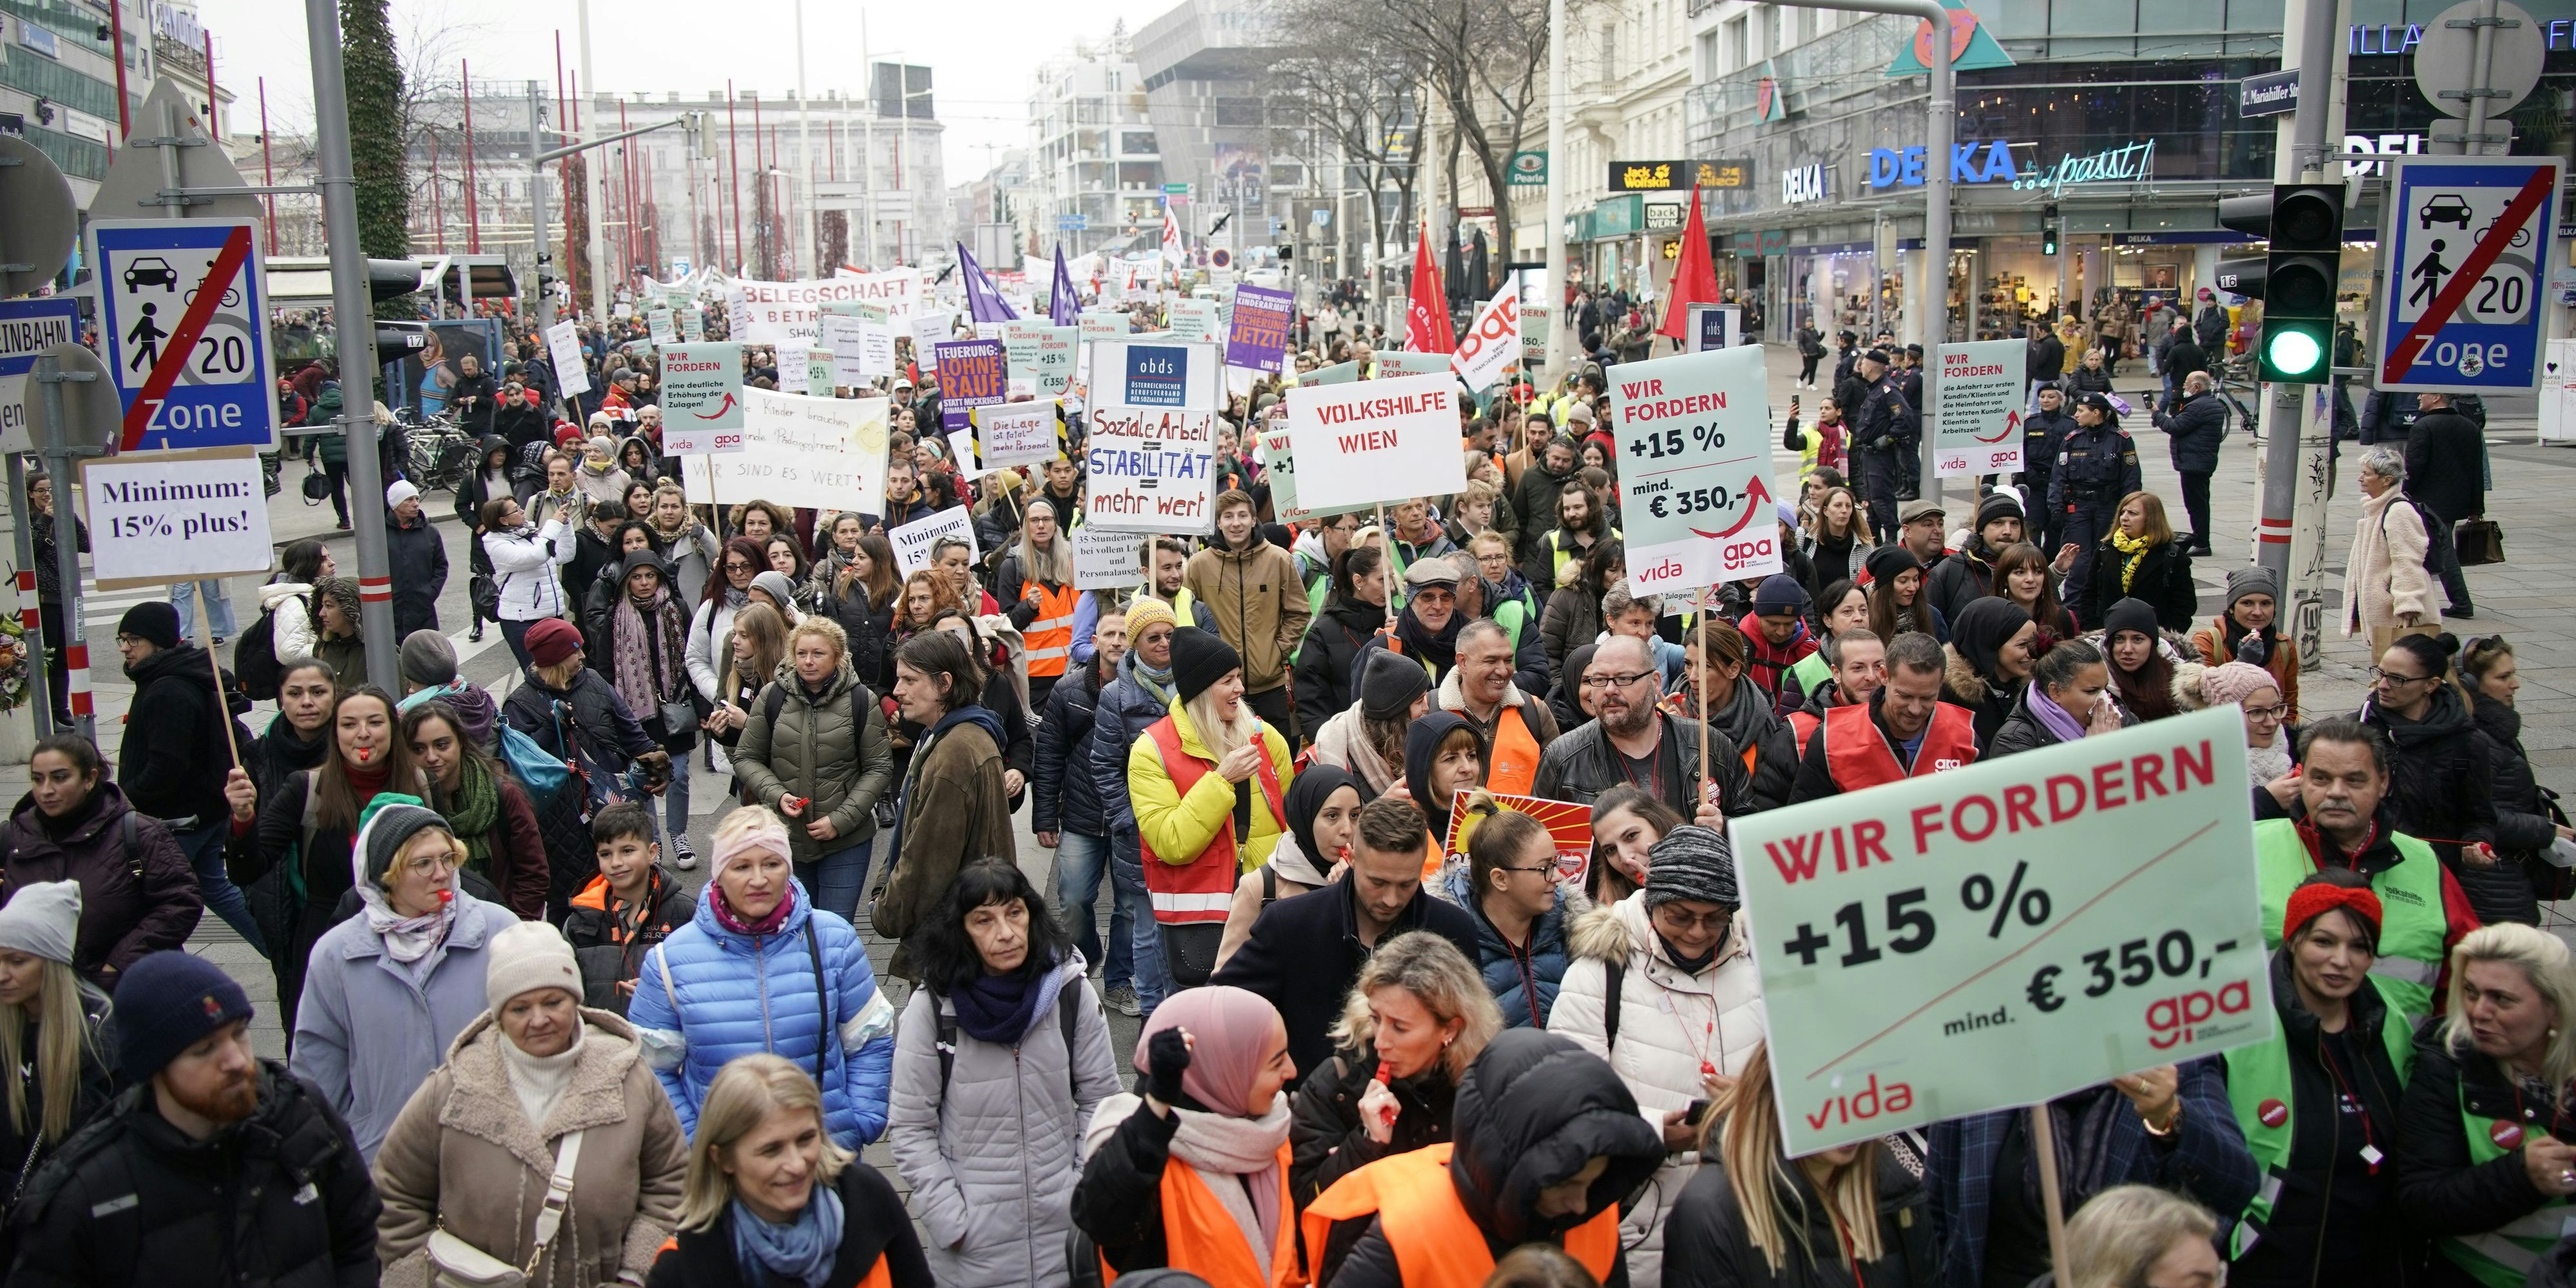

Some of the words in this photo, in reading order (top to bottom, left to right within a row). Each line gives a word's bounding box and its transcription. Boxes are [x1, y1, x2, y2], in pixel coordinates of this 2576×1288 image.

[2349, 23, 2420, 55] ILLA
[2251, 85, 2288, 104] Mariahilfer
[2289, 82, 2299, 97] Str
[1871, 140, 2016, 187] DEKA
[1515, 173, 1545, 183] Pearle
[1624, 166, 1651, 178] Jack
[1624, 176, 1670, 189] Wolfskin
[1783, 164, 1823, 204] DELKA
[1650, 207, 1675, 217] back
[1648, 218, 1678, 228] WERK
[2222, 276, 2236, 287] 16
[742, 278, 909, 303] BELEGSCHAFT
[2477, 276, 2523, 314] 20
[1236, 297, 1291, 312] KINDERARMUT.
[747, 313, 755, 323] &
[1234, 313, 1288, 331] SICHERUNG
[0, 319, 66, 353] INBAHN
[1707, 321, 1720, 336] obds
[408, 335, 422, 347] 17
[1231, 325, 1285, 350] JETZT!
[202, 336, 244, 375] 20
[667, 352, 688, 361] WIR
[936, 345, 998, 359] TEUERUNG:
[1041, 355, 1056, 364] +15
[1059, 354, 1066, 363] %
[1528, 348, 1544, 356] gpa
[2411, 334, 2508, 368] Zone
[667, 362, 721, 373] FORDERN
[939, 356, 1000, 377] LÖHNE
[1140, 358, 1173, 374] obds
[1382, 359, 1401, 368] WIR
[1945, 354, 1969, 365] WIR
[809, 366, 820, 379] +15
[1944, 365, 2003, 378] FORDERN
[687, 381, 724, 389] deutliche
[942, 374, 1001, 399] RAUF
[1050, 377, 1068, 386] 350,-
[1131, 381, 1180, 390] ÖSTERREICHISCHER
[1303, 379, 1320, 388] WIR
[1620, 379, 1663, 400] WIR
[668, 392, 706, 400] Erhöhung
[943, 398, 963, 407] STATT
[964, 396, 1003, 406] MICKRIGER
[1944, 391, 1996, 400] Kundin/Klientin
[668, 401, 704, 409] Zulagen!
[764, 398, 795, 417] Kinder
[808, 406, 850, 428] brauchen
[1317, 391, 1447, 426] VOLKSHILFE
[1624, 392, 1727, 424] FORDERN
[144, 398, 243, 431] Zone
[994, 421, 1009, 430] Die
[1012, 419, 1040, 433] Lage
[1092, 409, 1154, 437] Soziale
[1156, 412, 1210, 442] Arbeit
[715, 434, 740, 448] gpa
[993, 431, 1003, 439] ist
[1007, 431, 1027, 440] fatal
[1268, 435, 1291, 451] WI
[1338, 429, 1398, 454] WIEN
[1629, 429, 1685, 459] +15
[1693, 421, 1725, 452] %
[669, 439, 693, 450] vida
[993, 443, 1014, 451] mehr
[1016, 439, 1050, 451] Personal
[1090, 448, 1212, 478] STABILITÄT
[1940, 457, 1966, 469] vida
[1991, 451, 2017, 468] gpa
[693, 462, 723, 478] WR
[737, 462, 773, 477] SIND
[782, 467, 797, 480] ES
[102, 480, 250, 504] Minimum:
[1633, 478, 1674, 495] mind.
[1095, 488, 1149, 515] mehr
[1157, 491, 1205, 517] wert
[1649, 495, 1669, 518] €
[1676, 486, 1746, 515] 350,-
[109, 513, 173, 538] 15%
[182, 509, 249, 541] plus!
[898, 518, 964, 548] Minimum:
[1079, 535, 1088, 544] 35
[1081, 547, 1094, 555] bei
[1096, 545, 1124, 554] vollem
[1723, 538, 1772, 570] gpa
[1110, 556, 1125, 565] und
[1639, 558, 1683, 583] vida
[1665, 605, 1676, 614] vida
[1763, 819, 1894, 885] WIR
[1911, 739, 2217, 855] FORDERN
[1783, 886, 1937, 968] +15
[1960, 859, 2052, 939] %
[1943, 1004, 2016, 1037] mind.
[2026, 965, 2066, 1012] €
[2081, 929, 2238, 998] 350,-
[2145, 979, 2251, 1050] gpa
[1806, 1073, 1913, 1130] vida
